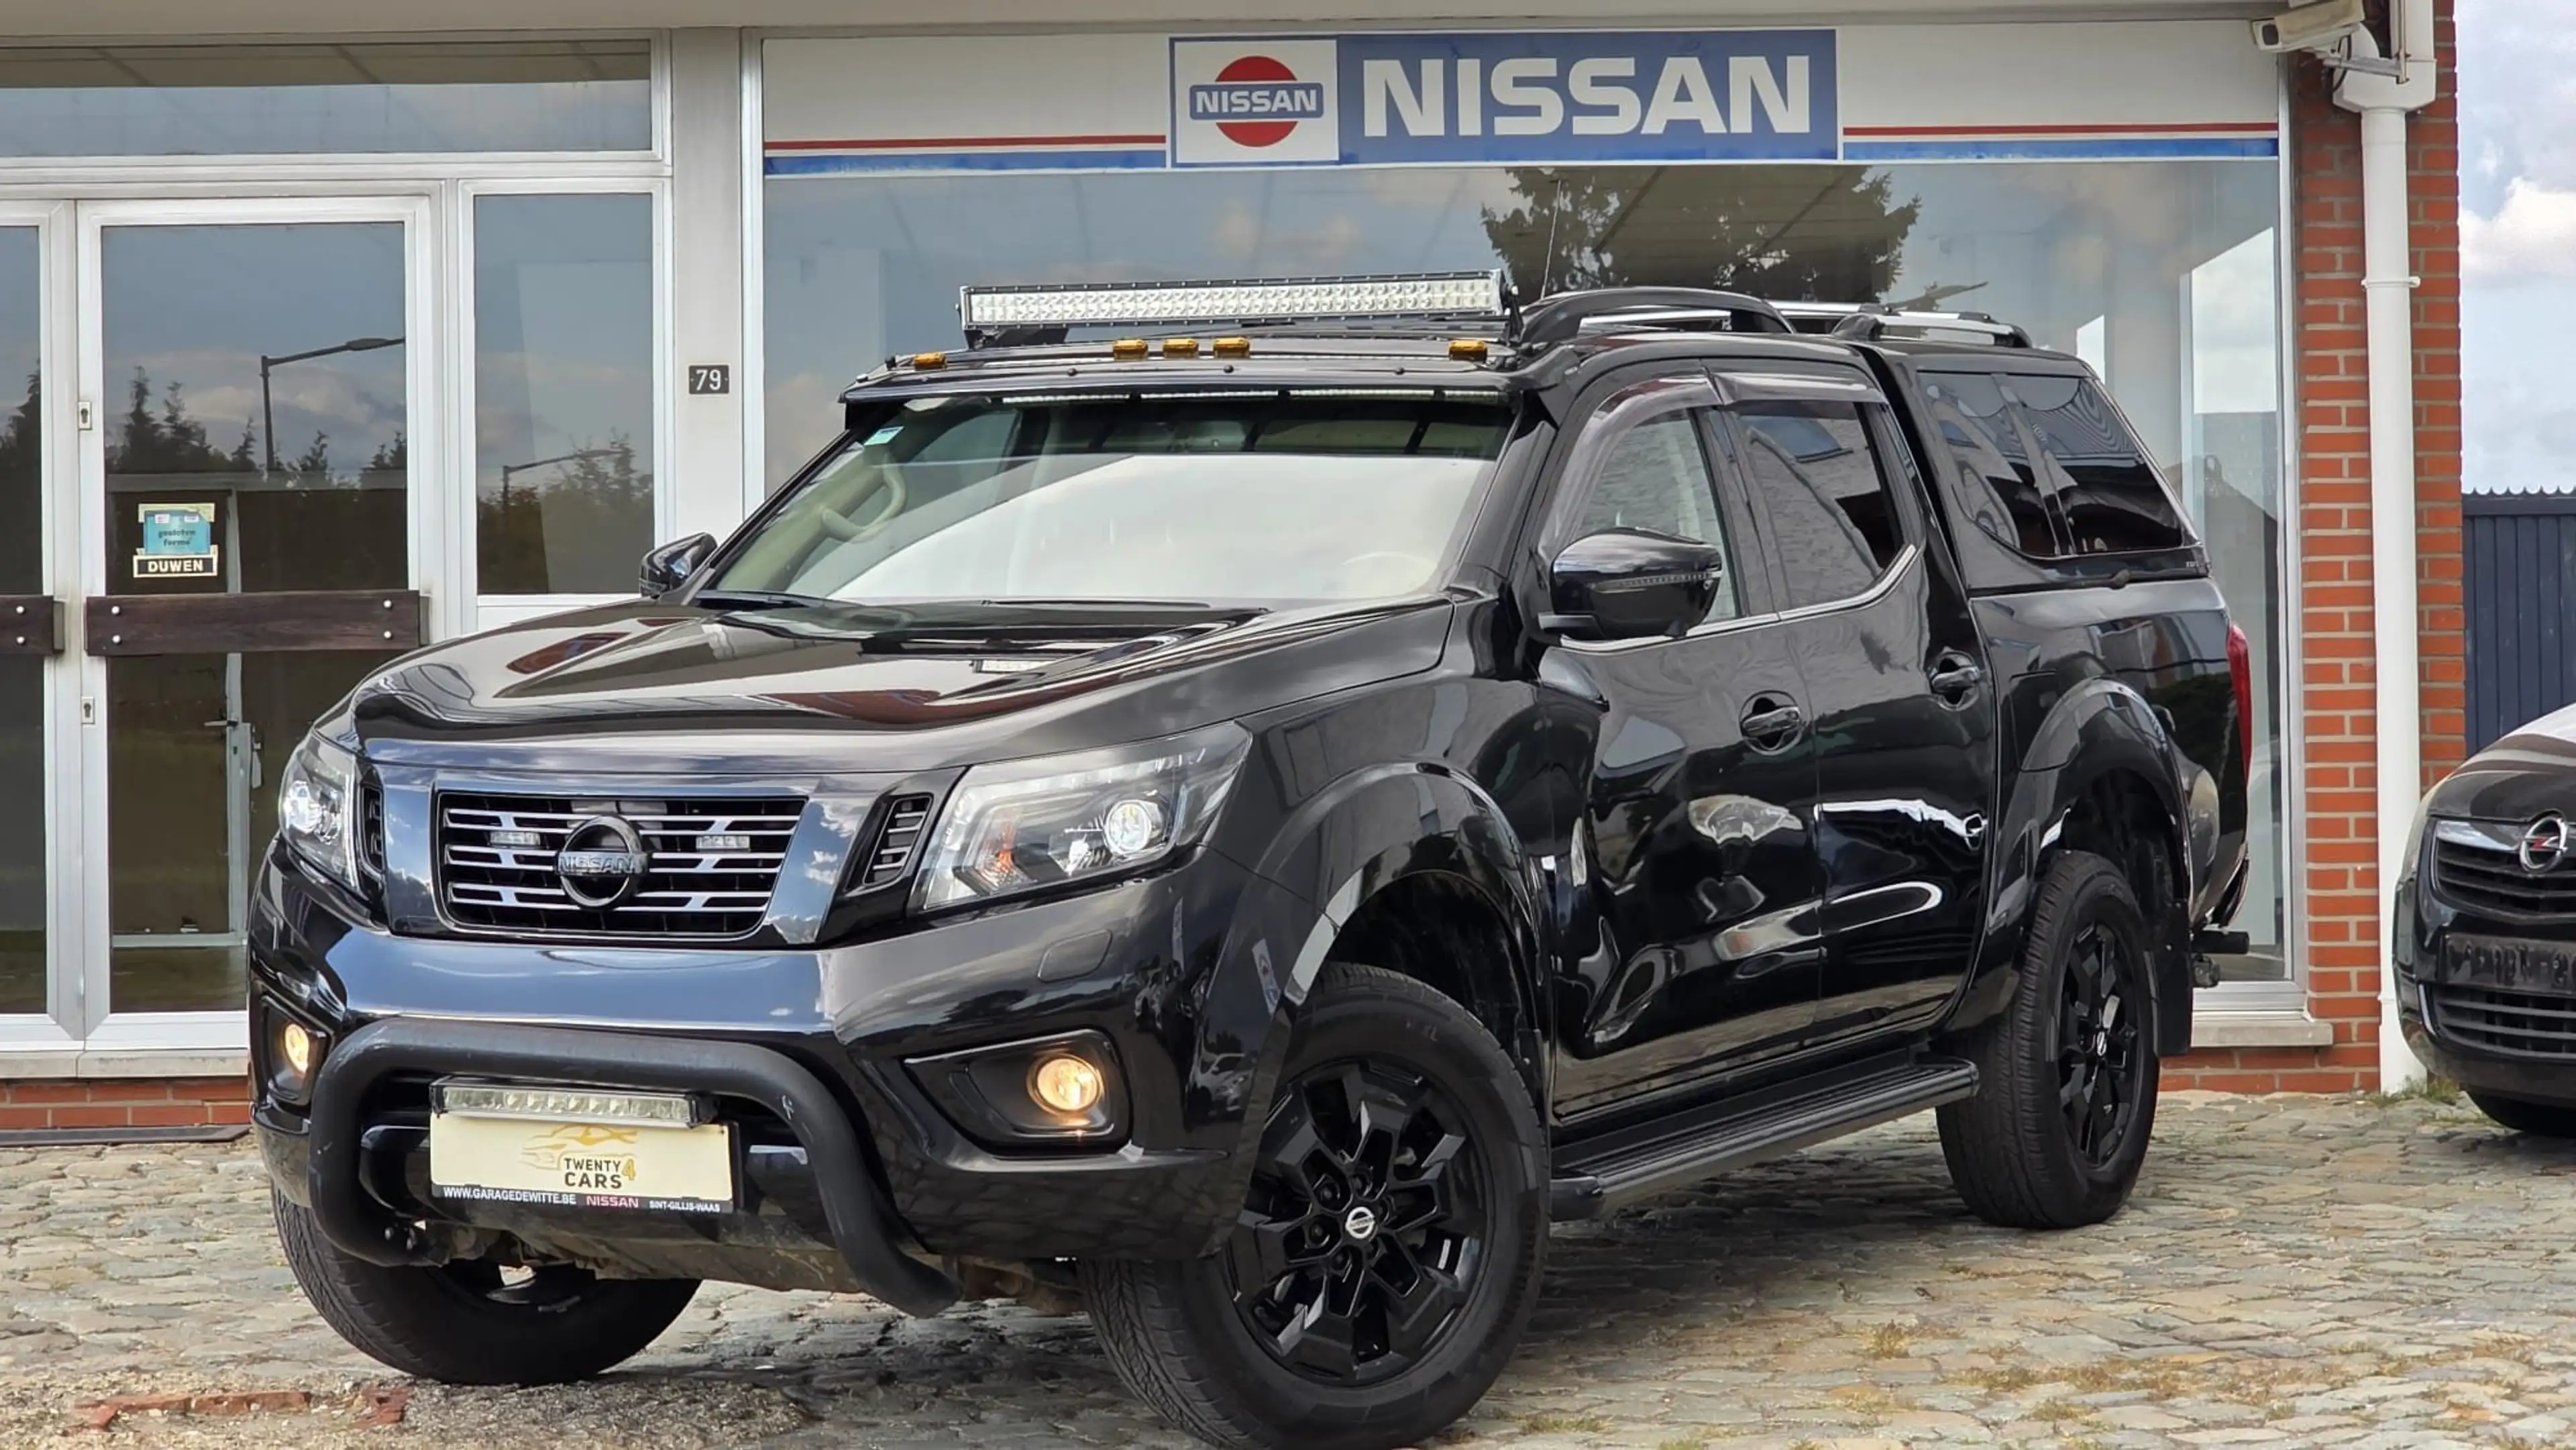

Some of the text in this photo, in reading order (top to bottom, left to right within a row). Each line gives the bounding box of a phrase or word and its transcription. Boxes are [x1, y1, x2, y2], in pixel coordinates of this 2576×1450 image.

[1195, 89, 1317, 113] NISSAN
[1362, 56, 1811, 138] NISSAN
[696, 369, 722, 391] 79
[148, 560, 204, 572] DUWEN
[559, 856, 633, 874] NISSAN
[564, 1157, 637, 1181] TWENTY 4
[564, 1172, 623, 1189] CARS
[443, 1186, 721, 1213] WWW.GARAGEDEWITTE.BE NISSAN SINT-GILLIS-WAAS
